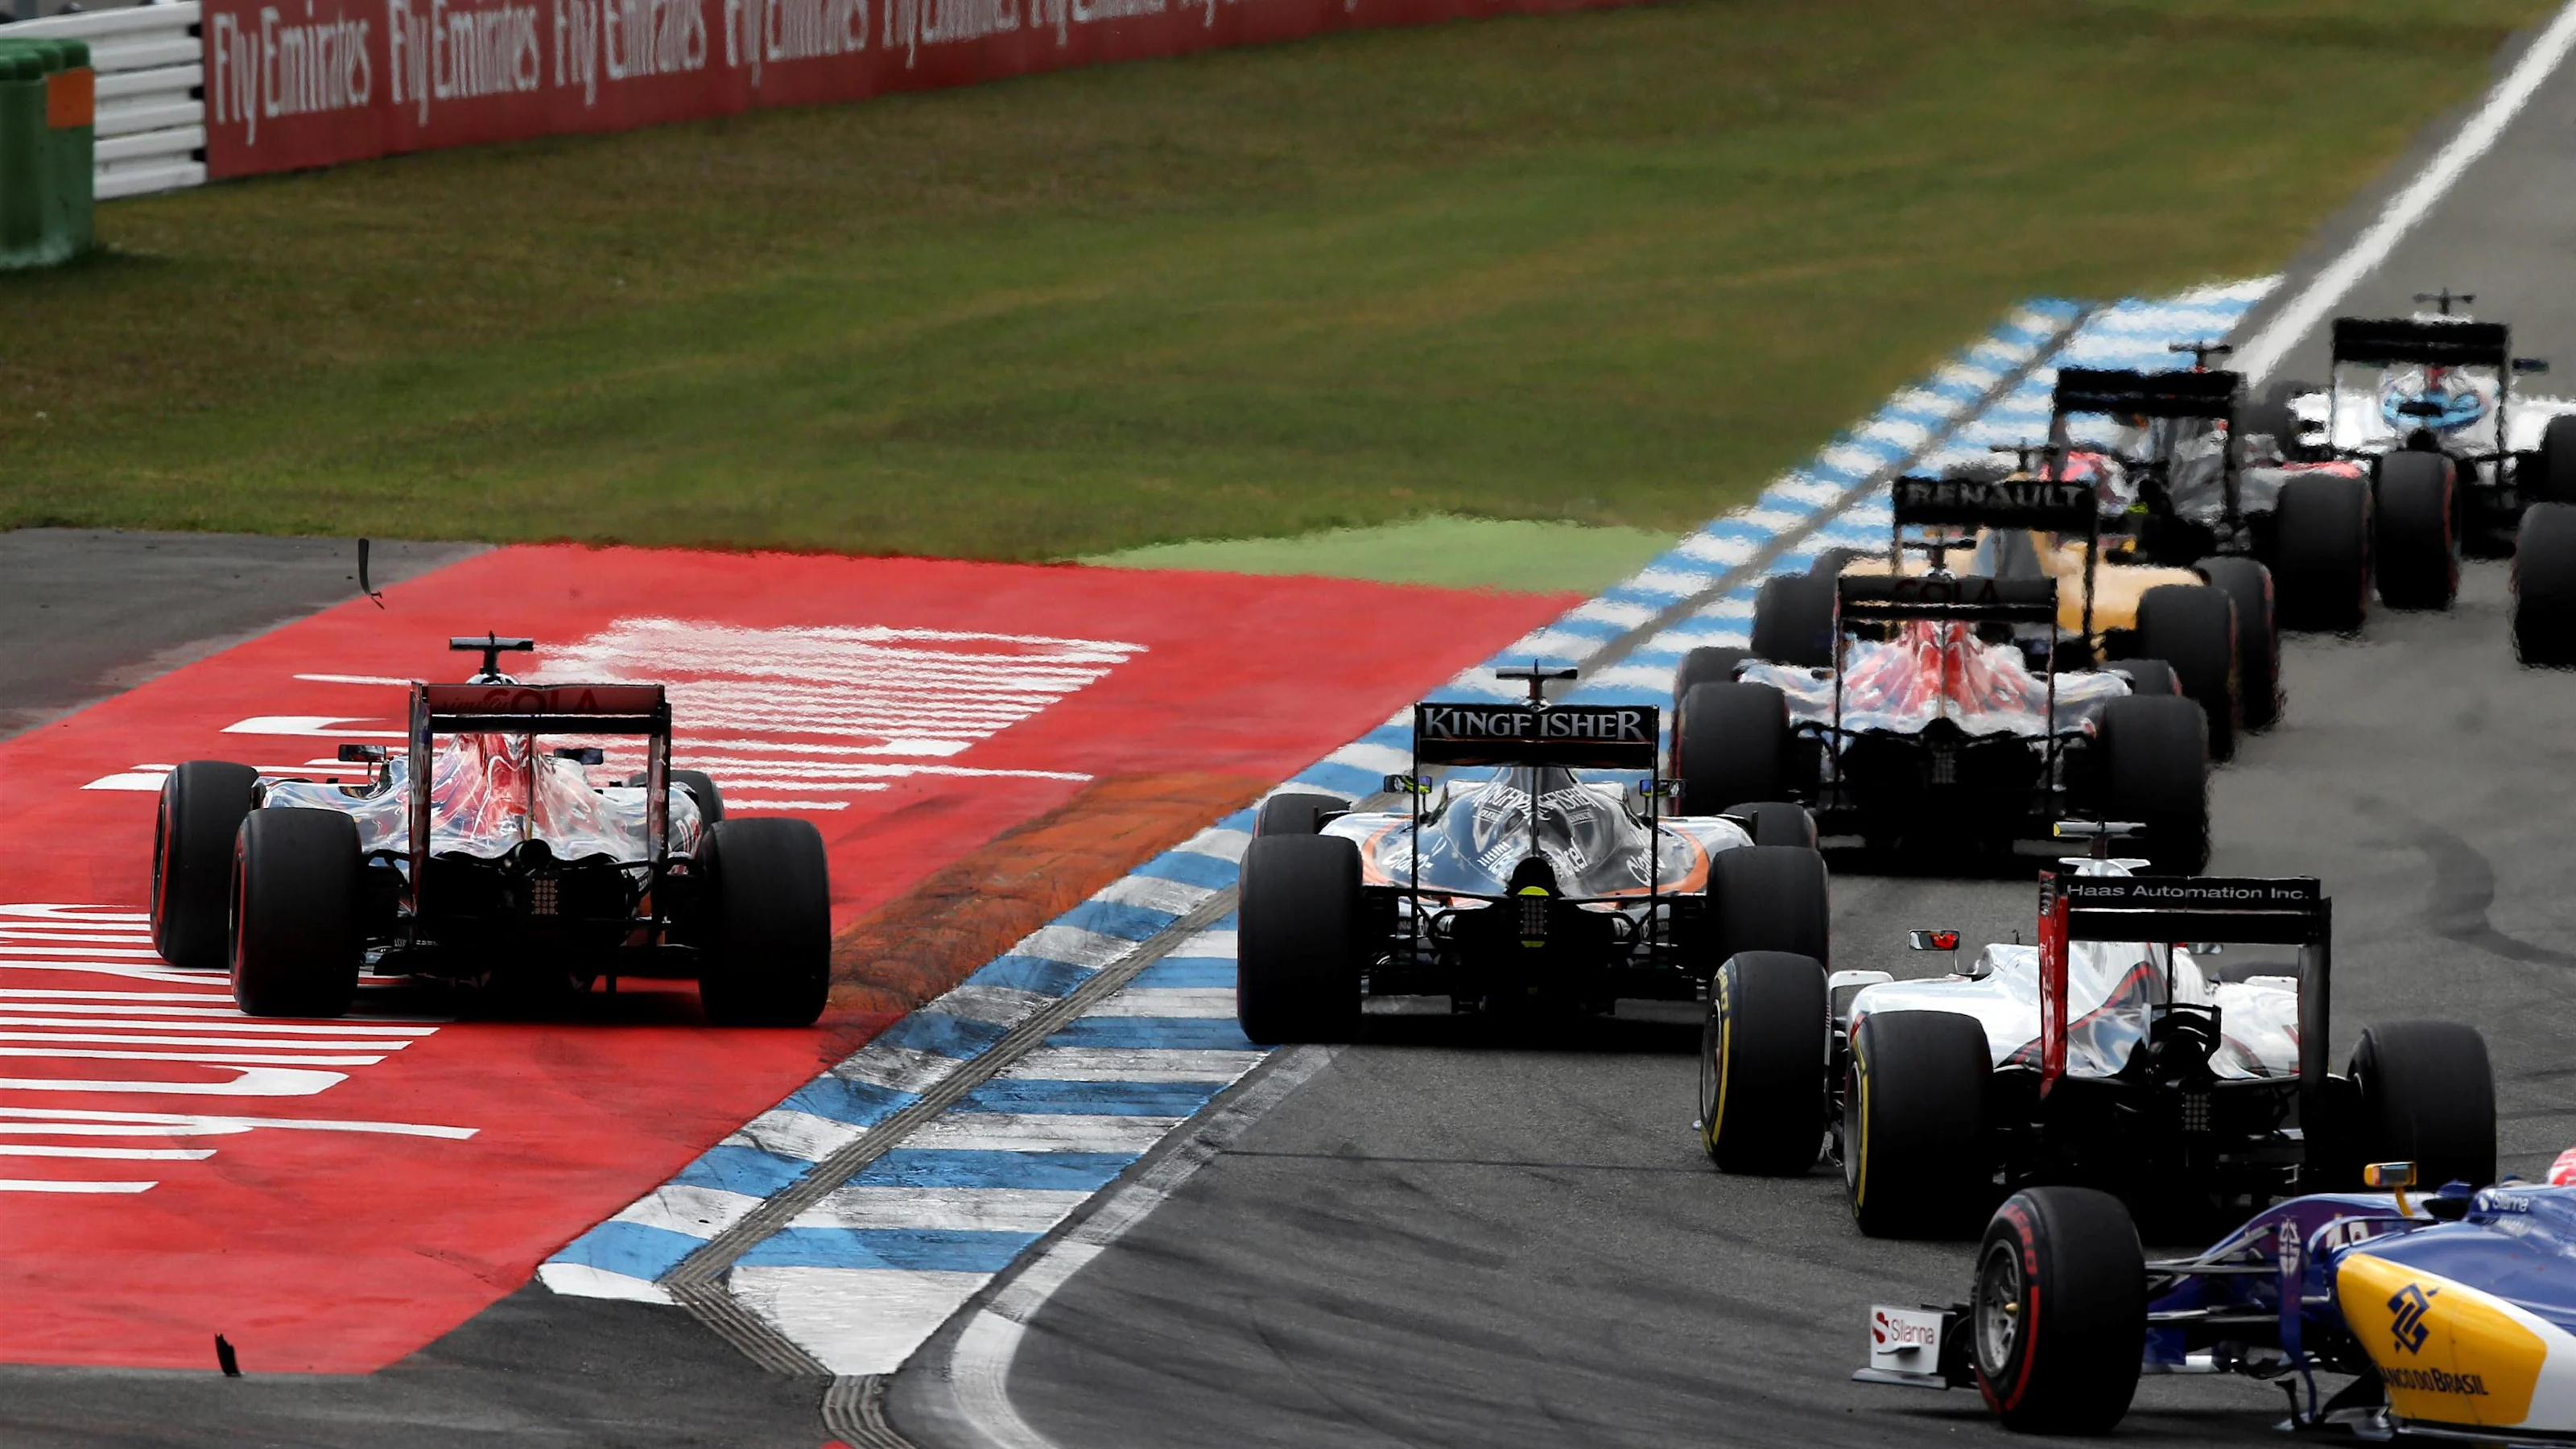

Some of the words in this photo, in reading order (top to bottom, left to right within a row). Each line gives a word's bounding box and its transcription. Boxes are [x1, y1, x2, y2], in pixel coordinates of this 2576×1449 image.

[213, 11, 258, 147] Fly
[260, 0, 371, 118] Emirates
[390, 0, 429, 127] Fly
[431, 0, 539, 99] Emirates
[1906, 482, 2085, 507] RENAULT
[1423, 708, 1649, 741] KINGFISHER
[2067, 885, 2125, 897] Haas
[2132, 885, 2266, 899] Automation
[2270, 887, 2310, 900] Inc.
[2429, 1367, 2489, 1396] BRASIL
